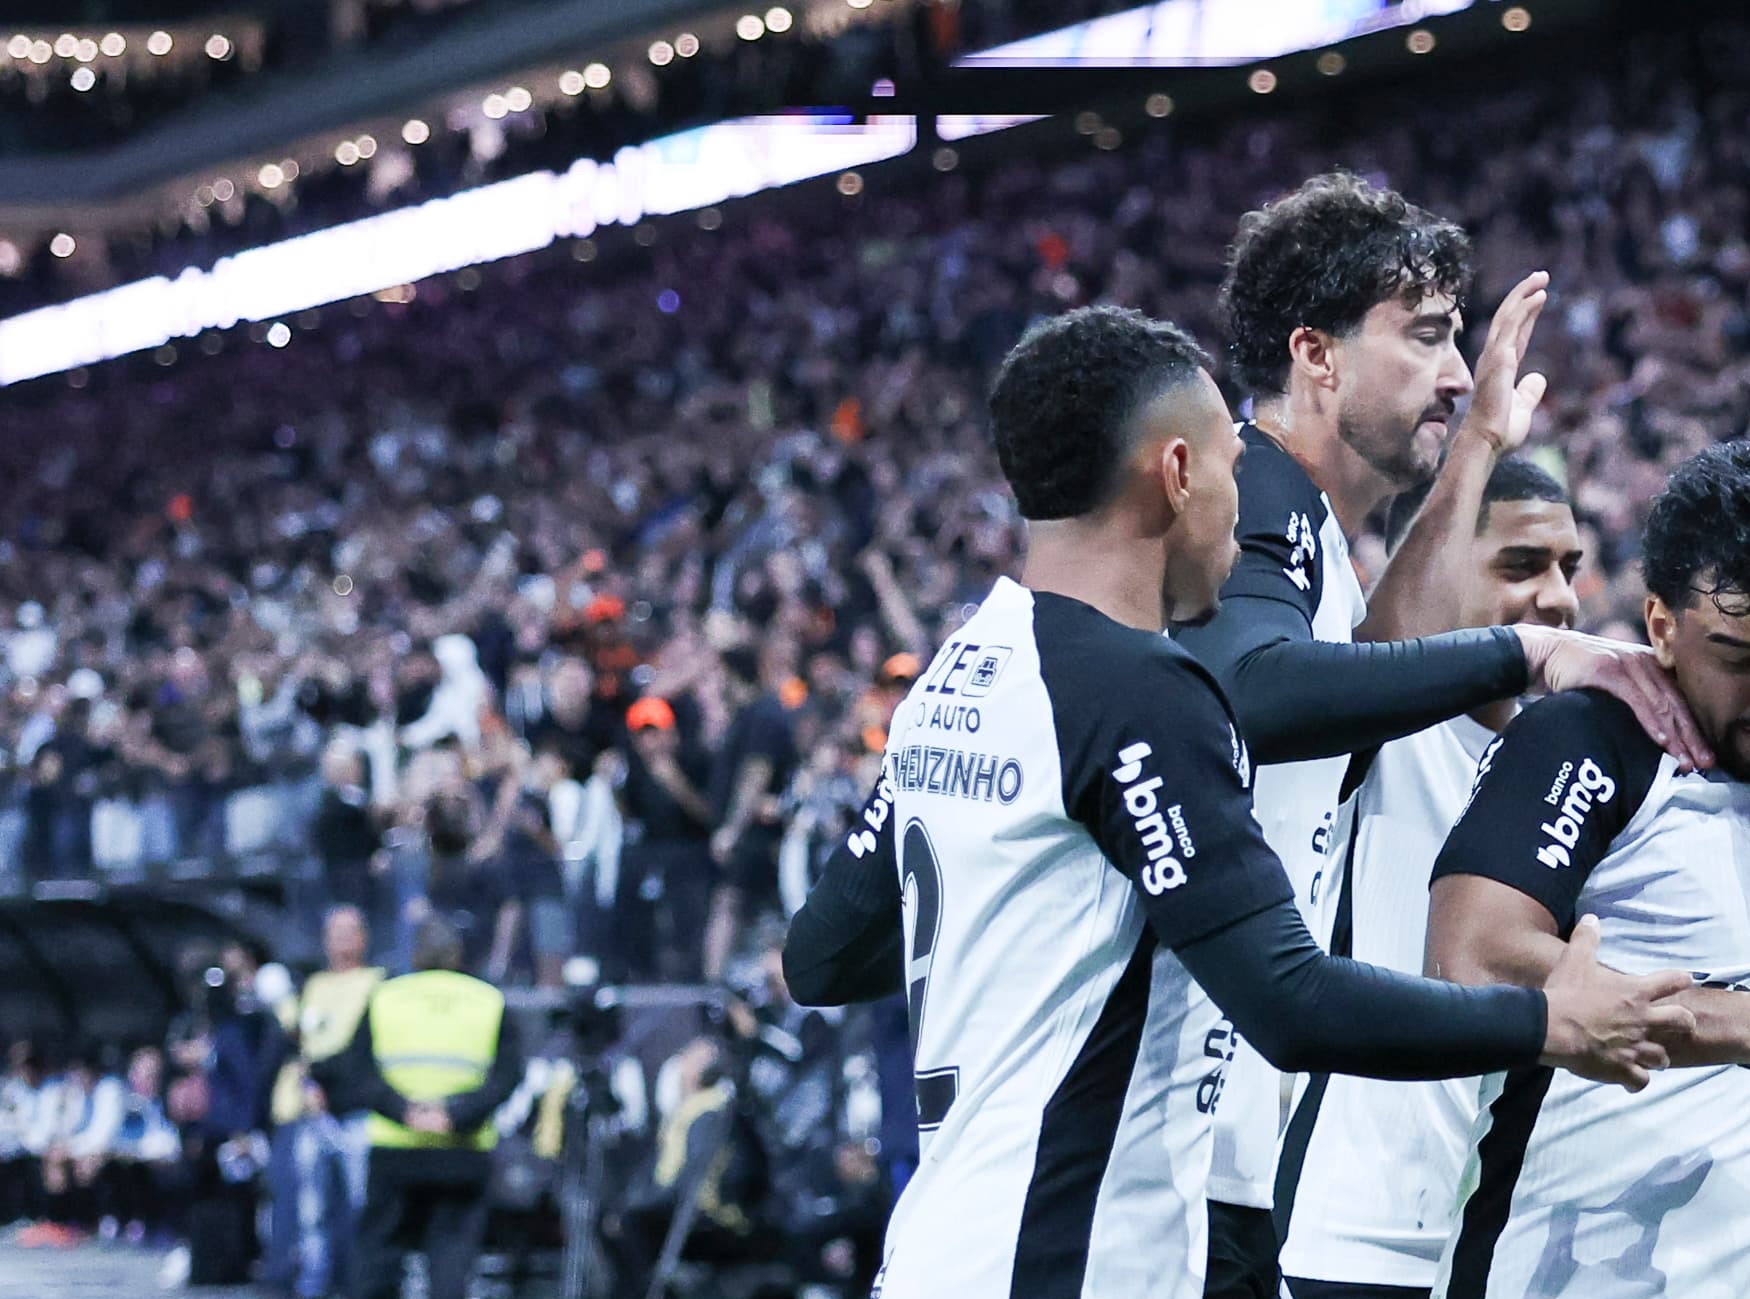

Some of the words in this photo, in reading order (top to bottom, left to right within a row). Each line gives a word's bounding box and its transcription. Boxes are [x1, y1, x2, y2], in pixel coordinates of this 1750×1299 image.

[929, 703, 981, 734] AUTO
[1540, 757, 1616, 850] bmg
[1543, 760, 1574, 806] banco
[1122, 775, 1188, 896] bmg
[1167, 803, 1196, 858] banco
